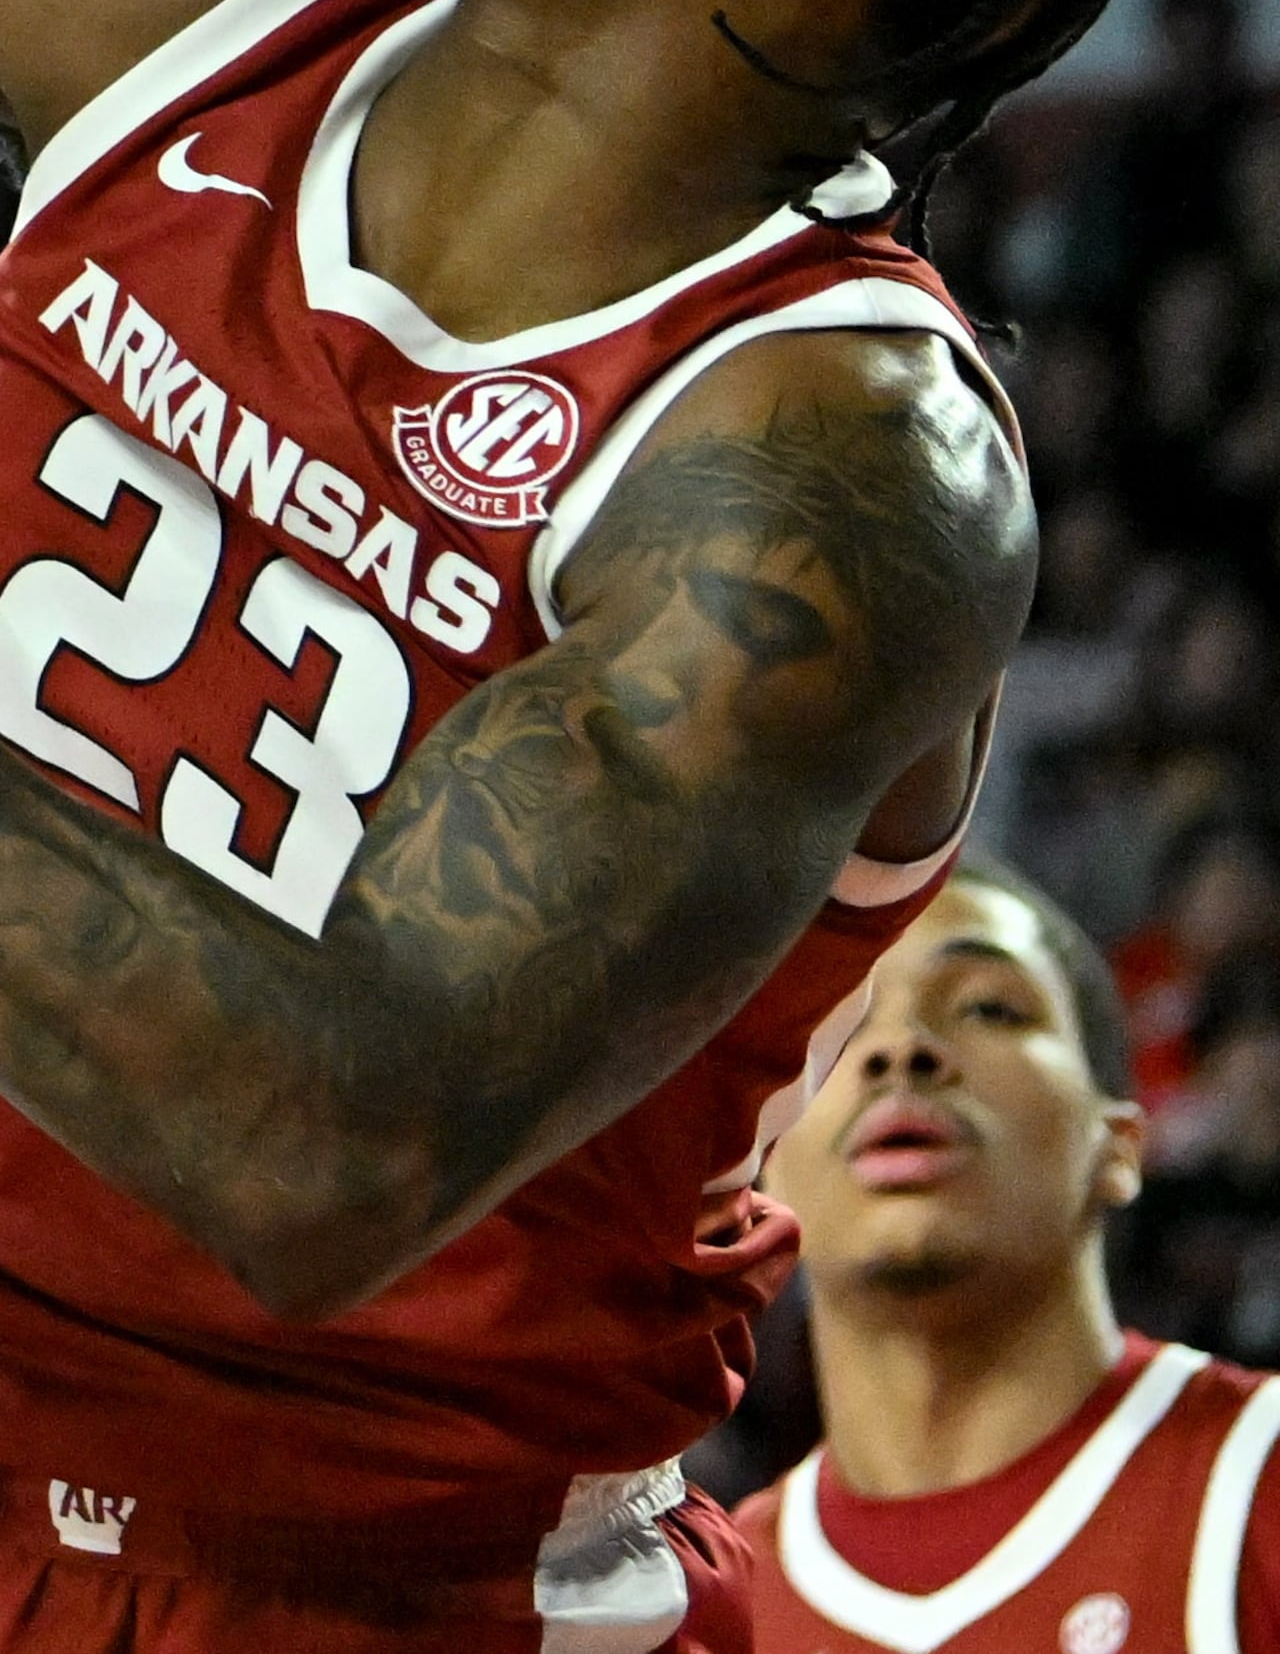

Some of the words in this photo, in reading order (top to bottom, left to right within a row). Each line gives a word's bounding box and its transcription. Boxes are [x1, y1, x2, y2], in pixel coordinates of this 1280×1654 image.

[40, 257, 502, 654] ARKANSAS
[446, 383, 564, 478] SEC
[405, 436, 508, 516] GRADUATE
[57, 1484, 128, 1527] AR
